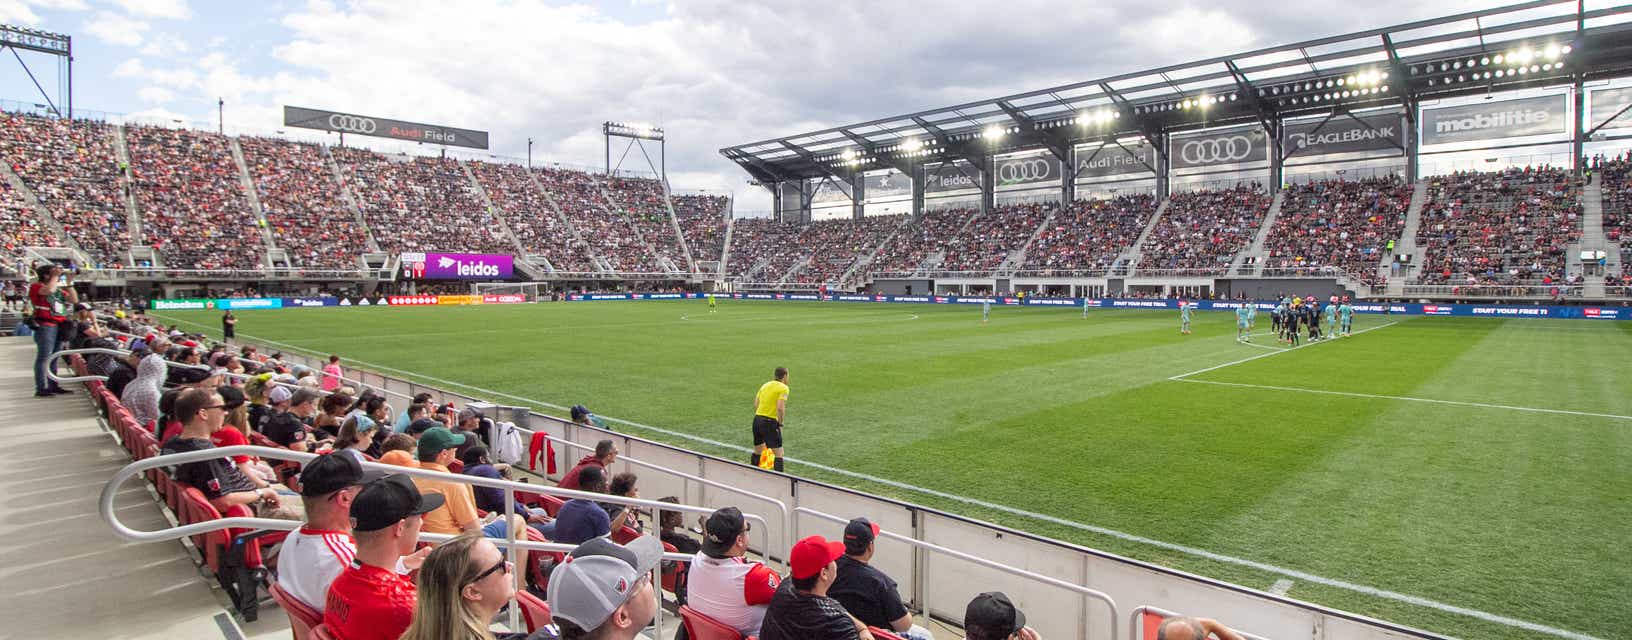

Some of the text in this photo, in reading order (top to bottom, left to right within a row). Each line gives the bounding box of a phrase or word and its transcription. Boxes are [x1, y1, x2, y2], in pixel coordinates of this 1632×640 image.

[1436, 110, 1551, 132] mobilitie
[389, 127, 456, 143] Audi Field
[1079, 152, 1146, 169] Audi Field
[940, 174, 972, 187] leidos
[457, 260, 500, 276] leidos
